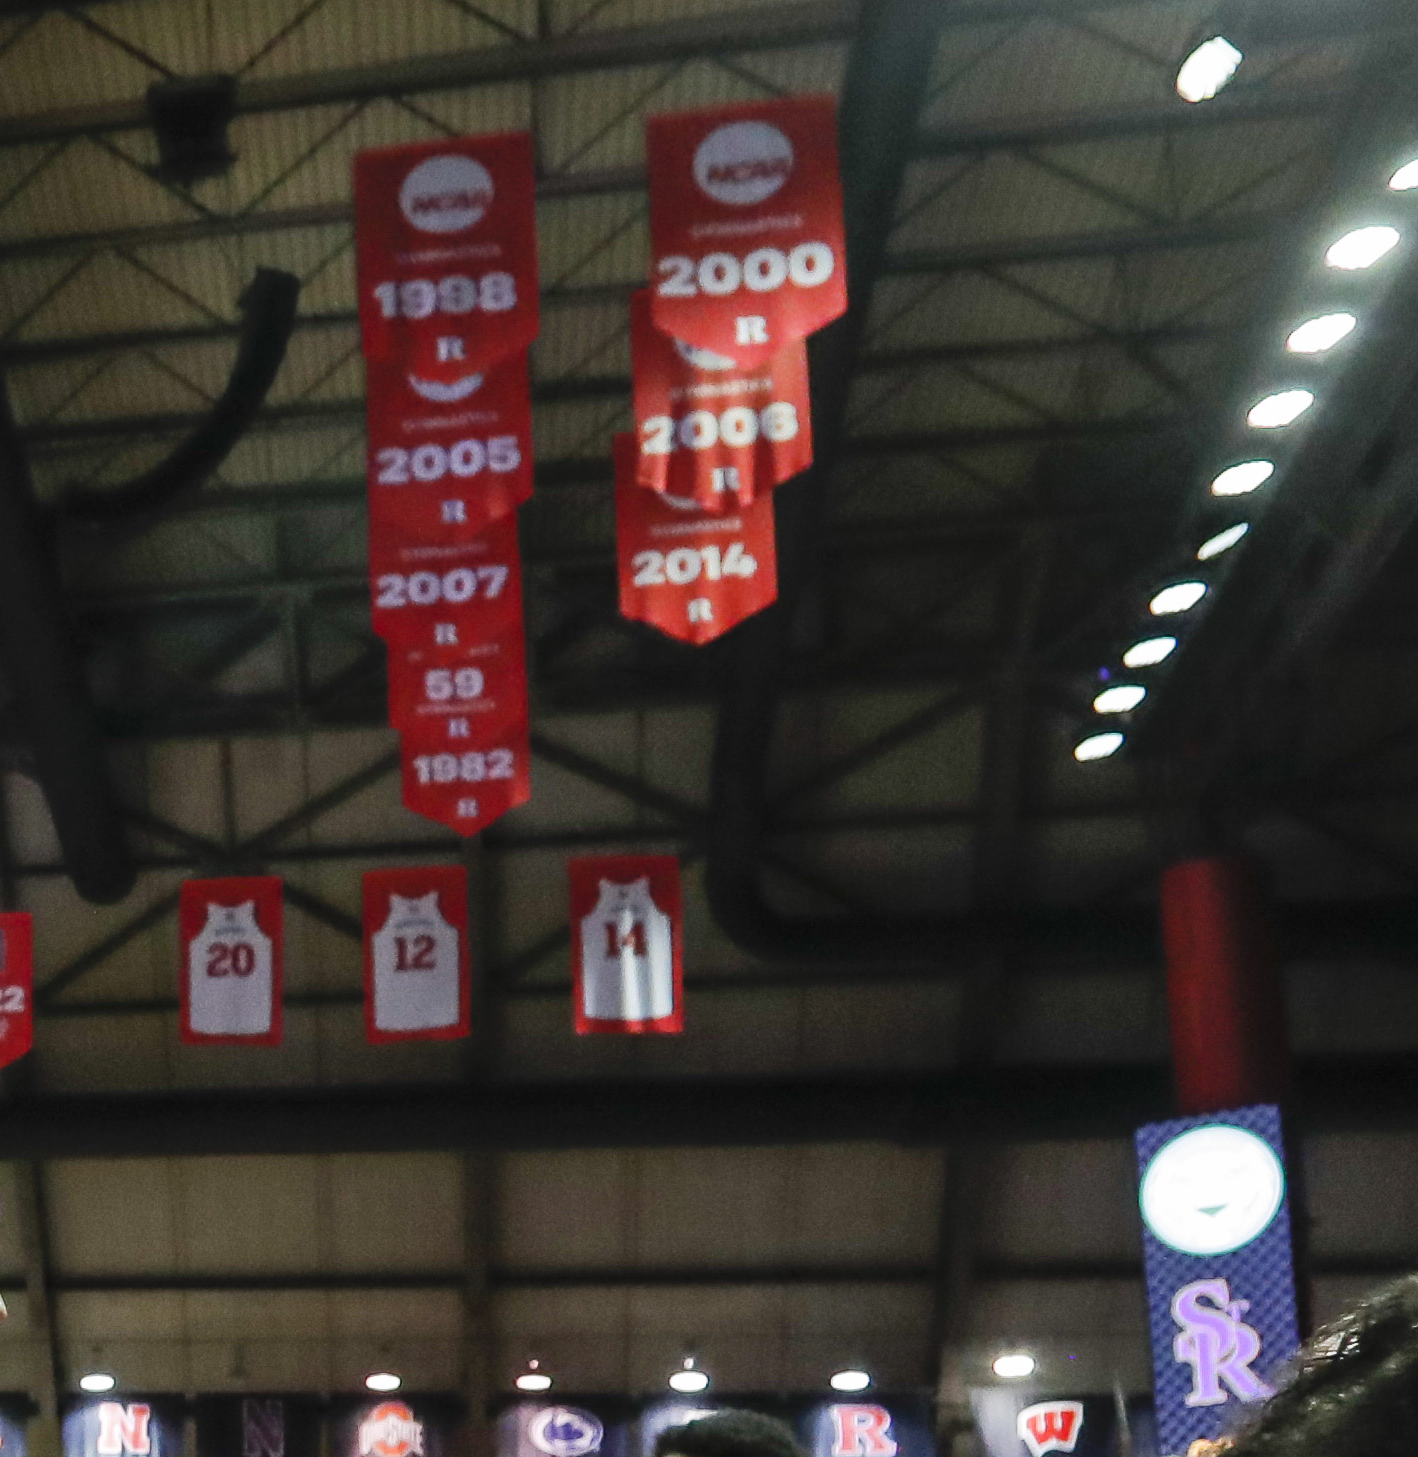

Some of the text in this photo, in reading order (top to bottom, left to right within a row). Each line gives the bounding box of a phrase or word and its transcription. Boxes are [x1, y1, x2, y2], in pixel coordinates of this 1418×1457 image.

[658, 240, 835, 298] 2000
[734, 315, 770, 346] R
[375, 435, 522, 485] 2005
[376, 564, 509, 609] 2007
[631, 541, 758, 587] 2014
[205, 942, 257, 978] 20
[393, 934, 436, 973] 12
[96, 1402, 152, 1455] N
[1019, 1403, 1083, 1456] W
